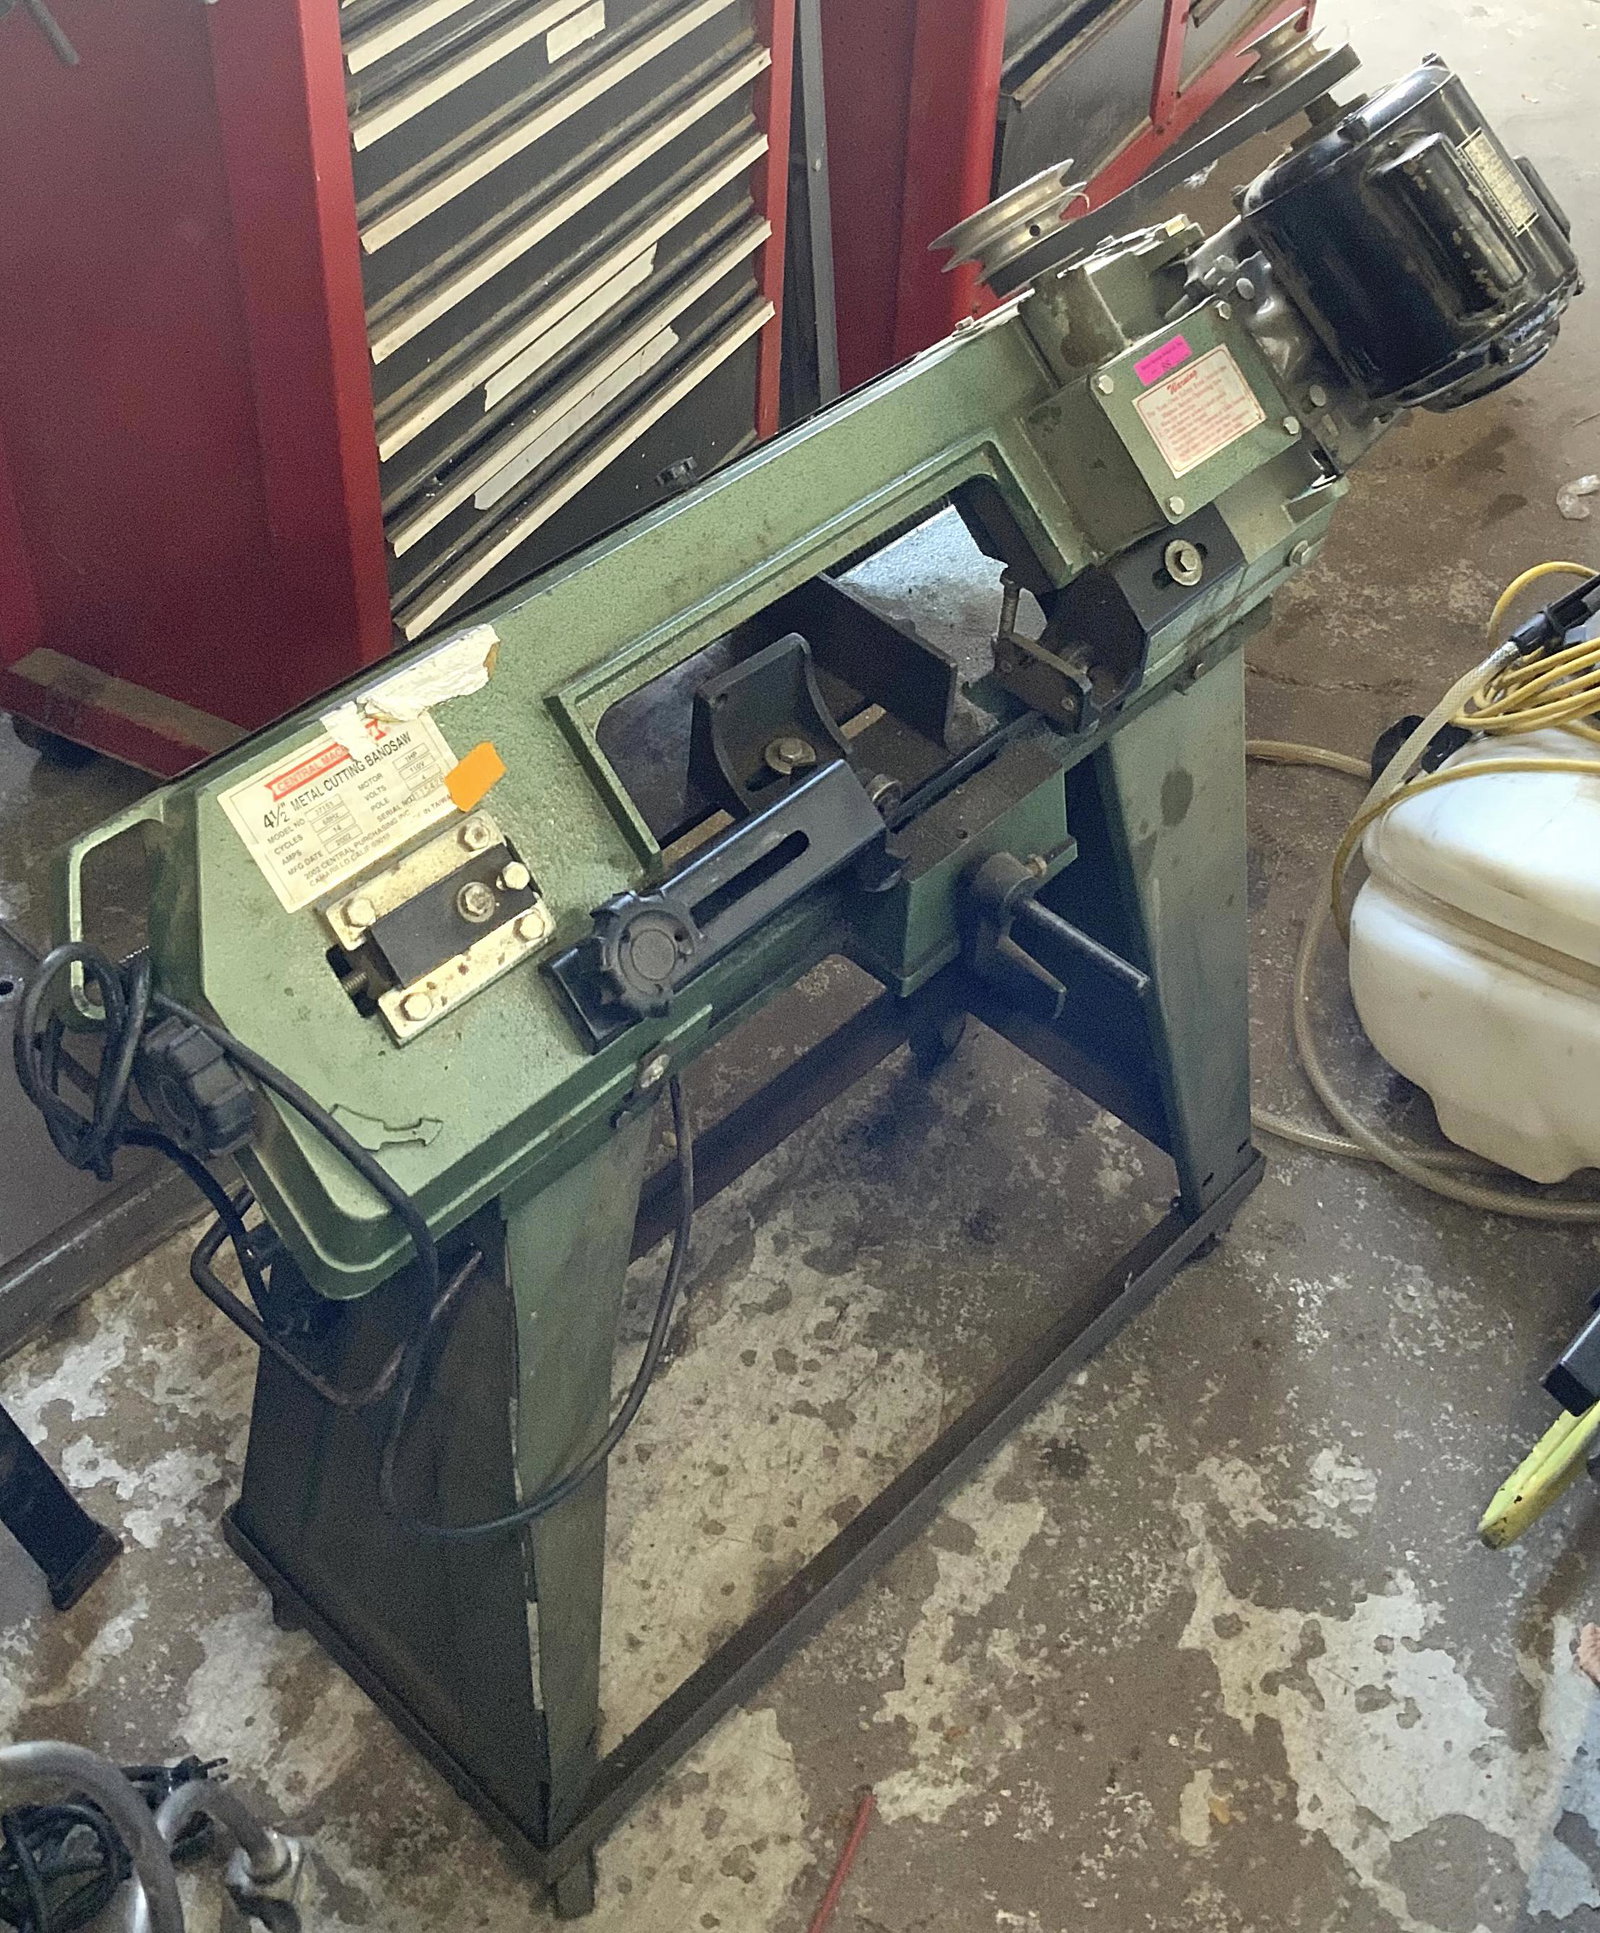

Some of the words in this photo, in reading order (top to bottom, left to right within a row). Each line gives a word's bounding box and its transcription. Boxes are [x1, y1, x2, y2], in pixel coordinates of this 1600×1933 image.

[276, 760, 321, 792] CENTRAL
[289, 784, 324, 811] METAL
[322, 759, 366, 791] CUTTING
[363, 731, 413, 766] BANDSAW
[357, 772, 383, 791] MOTOR
[404, 750, 418, 762] 1HP
[363, 783, 387, 801] VOLTS
[369, 796, 390, 812] POLE
[376, 803, 402, 822] SERIAL
[266, 825, 293, 844] MODEL
[273, 833, 304, 855] CYCLES
[319, 845, 354, 869] CENTRAL
[352, 817, 398, 848] PURCHASING
[280, 848, 303, 865] AMPS
[286, 861, 304, 876] MFG
[303, 849, 323, 865] DATE
